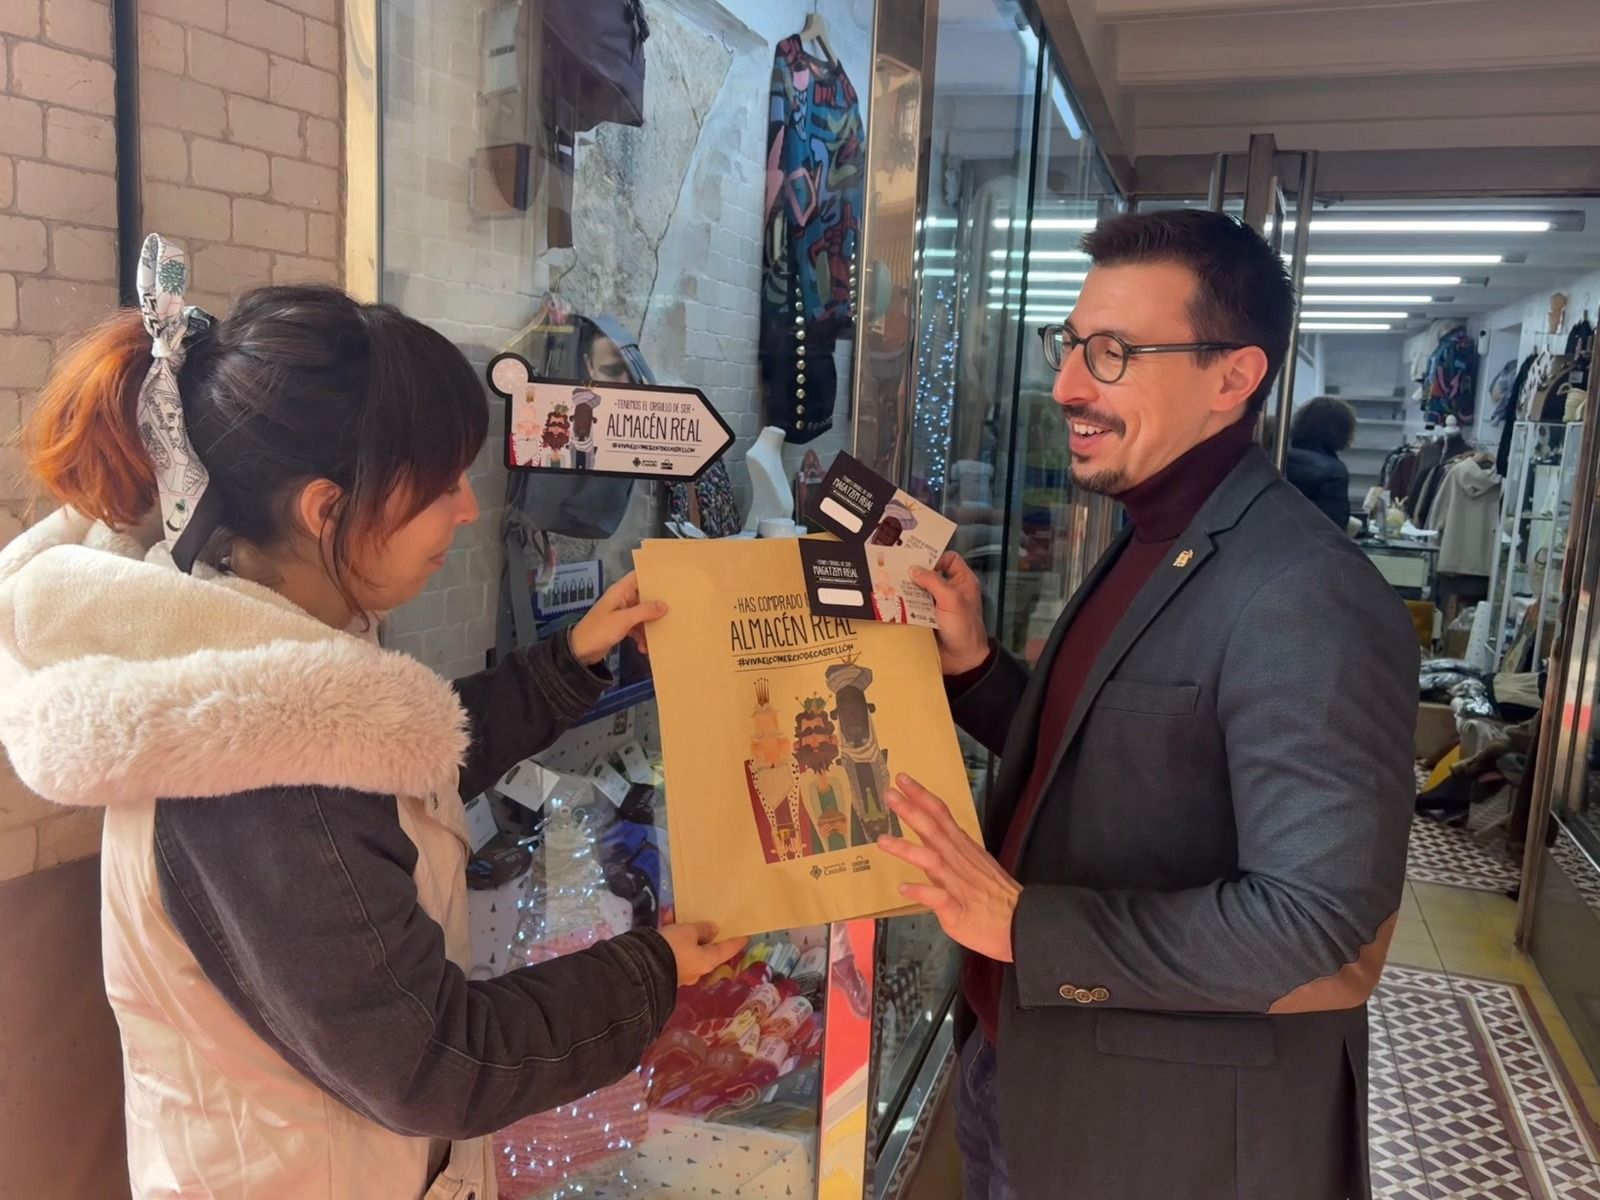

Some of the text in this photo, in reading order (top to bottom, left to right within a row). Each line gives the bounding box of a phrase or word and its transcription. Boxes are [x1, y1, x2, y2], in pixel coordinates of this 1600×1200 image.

[617, 399, 692, 414] TENEMOS EL ORGULLO DE SER
[606, 412, 702, 442] ALMACÉN REAL
[737, 597, 757, 613] HAS
[758, 593, 803, 612] COMPRADO
[730, 611, 857, 651] ALMACÉN REAL
